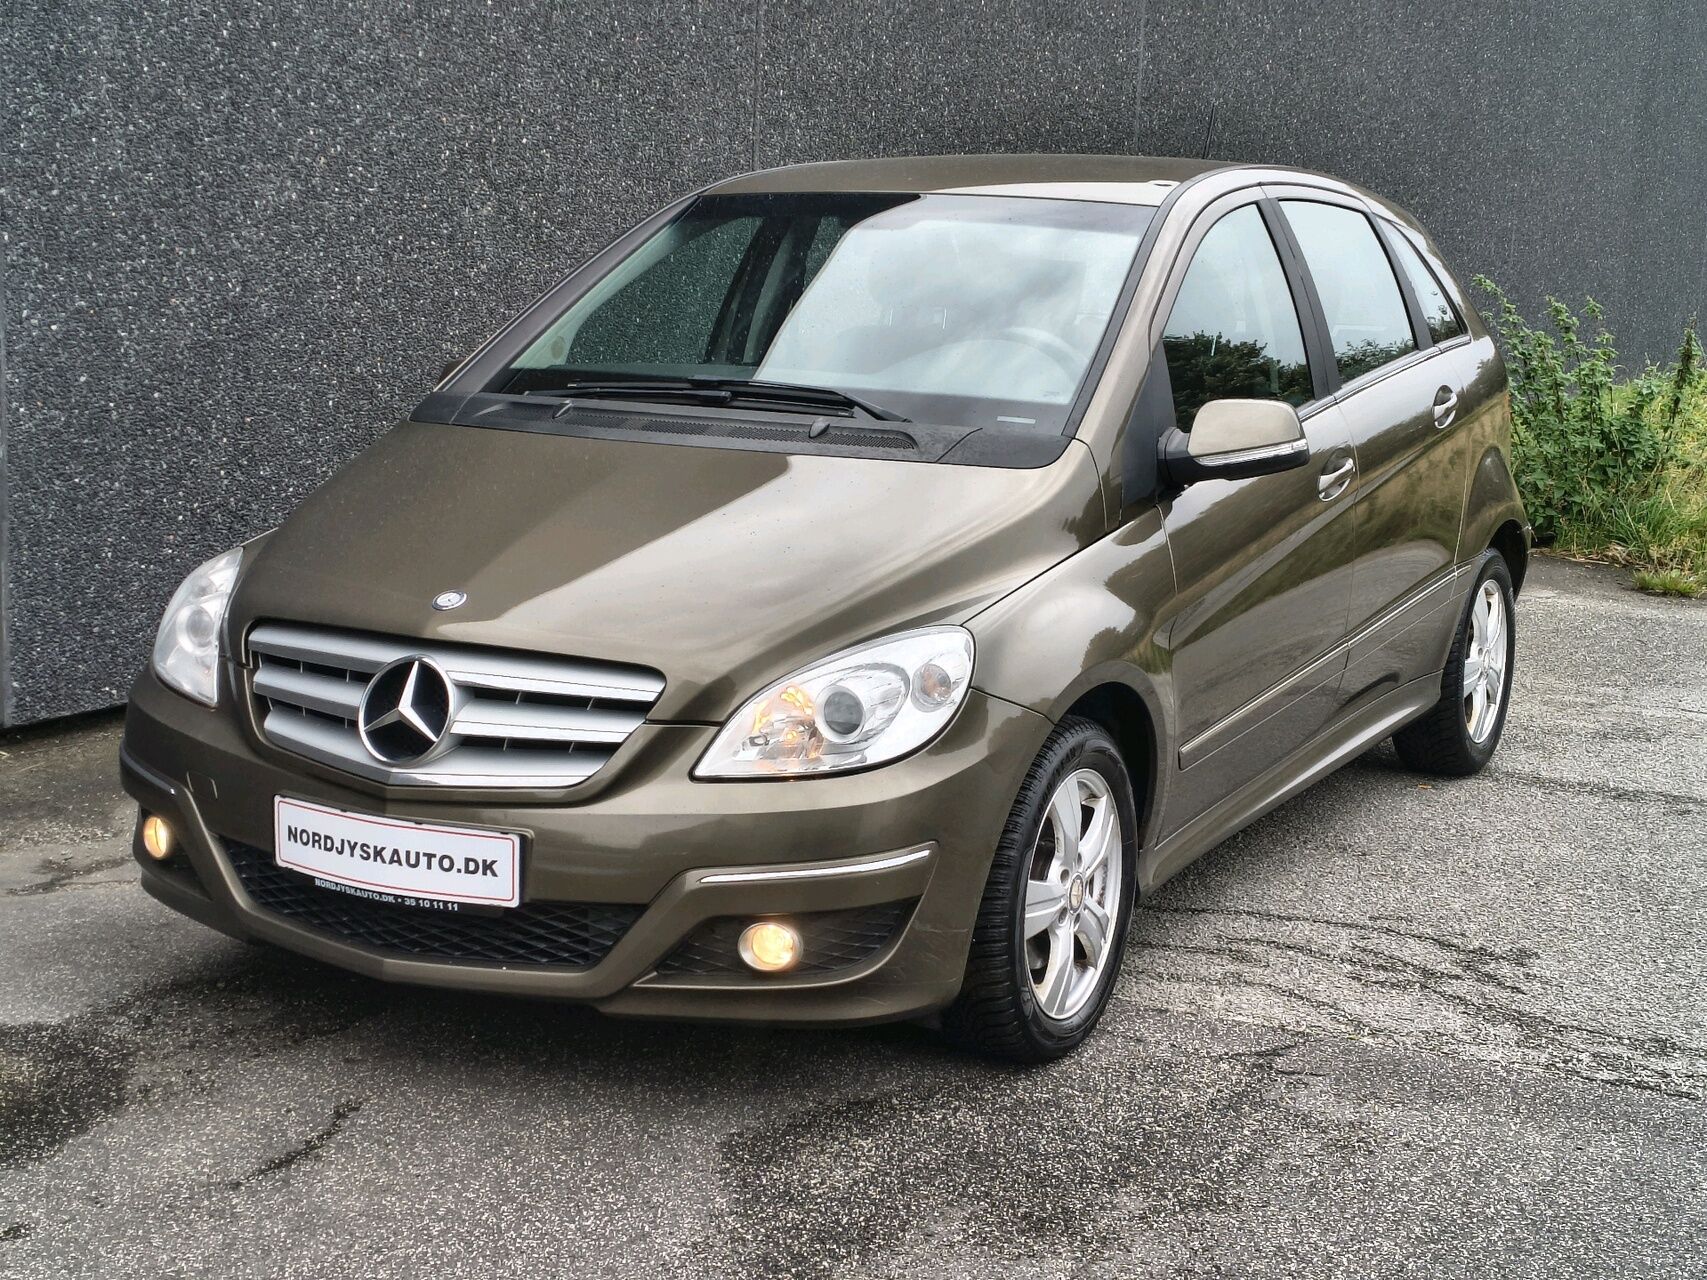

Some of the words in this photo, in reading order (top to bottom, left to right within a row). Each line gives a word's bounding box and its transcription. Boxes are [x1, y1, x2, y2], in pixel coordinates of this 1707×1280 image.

[287, 824, 498, 878] NORDJYSKAUTO.DK
[314, 877, 396, 904] NORDJYSKAUTO.DK
[404, 897, 416, 906] 35
[418, 899, 430, 908] 10
[432, 900, 444, 910] 11
[447, 902, 458, 912] 11
